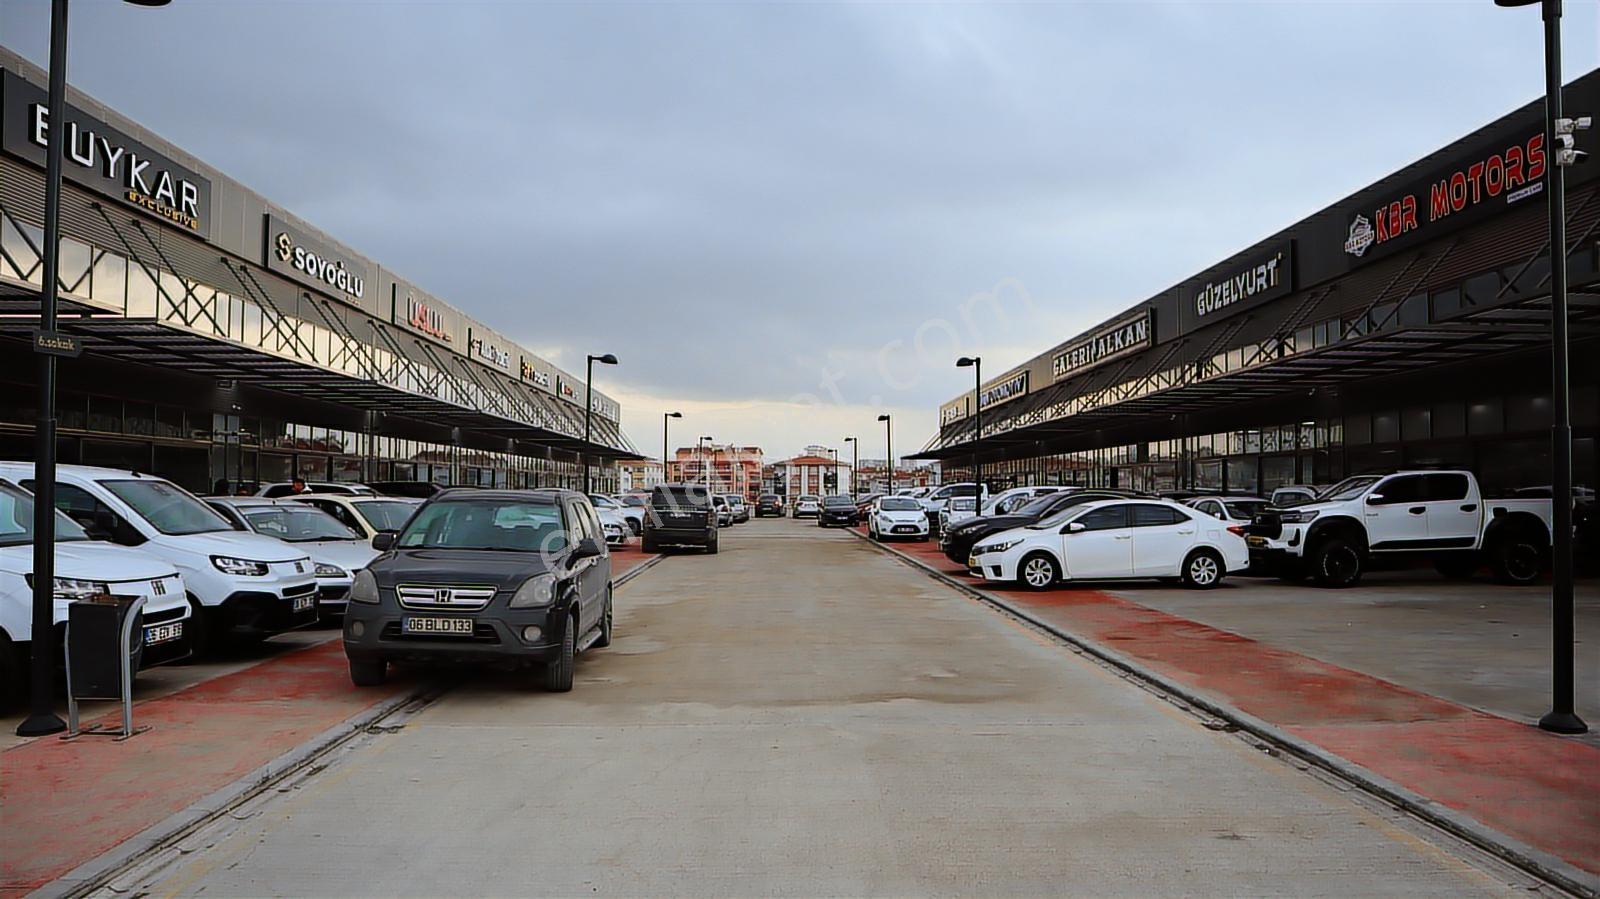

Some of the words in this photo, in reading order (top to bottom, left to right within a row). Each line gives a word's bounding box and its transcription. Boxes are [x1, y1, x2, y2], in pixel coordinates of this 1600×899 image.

[1376, 194, 1418, 244] KBR
[1430, 133, 1547, 221] MOTORS
[294, 246, 364, 298] SOYOĞLU
[1196, 257, 1278, 316] GÜZELYURT
[1096, 319, 1148, 359] ALKAN
[409, 618, 423, 631] 06
[452, 619, 472, 632] 133
